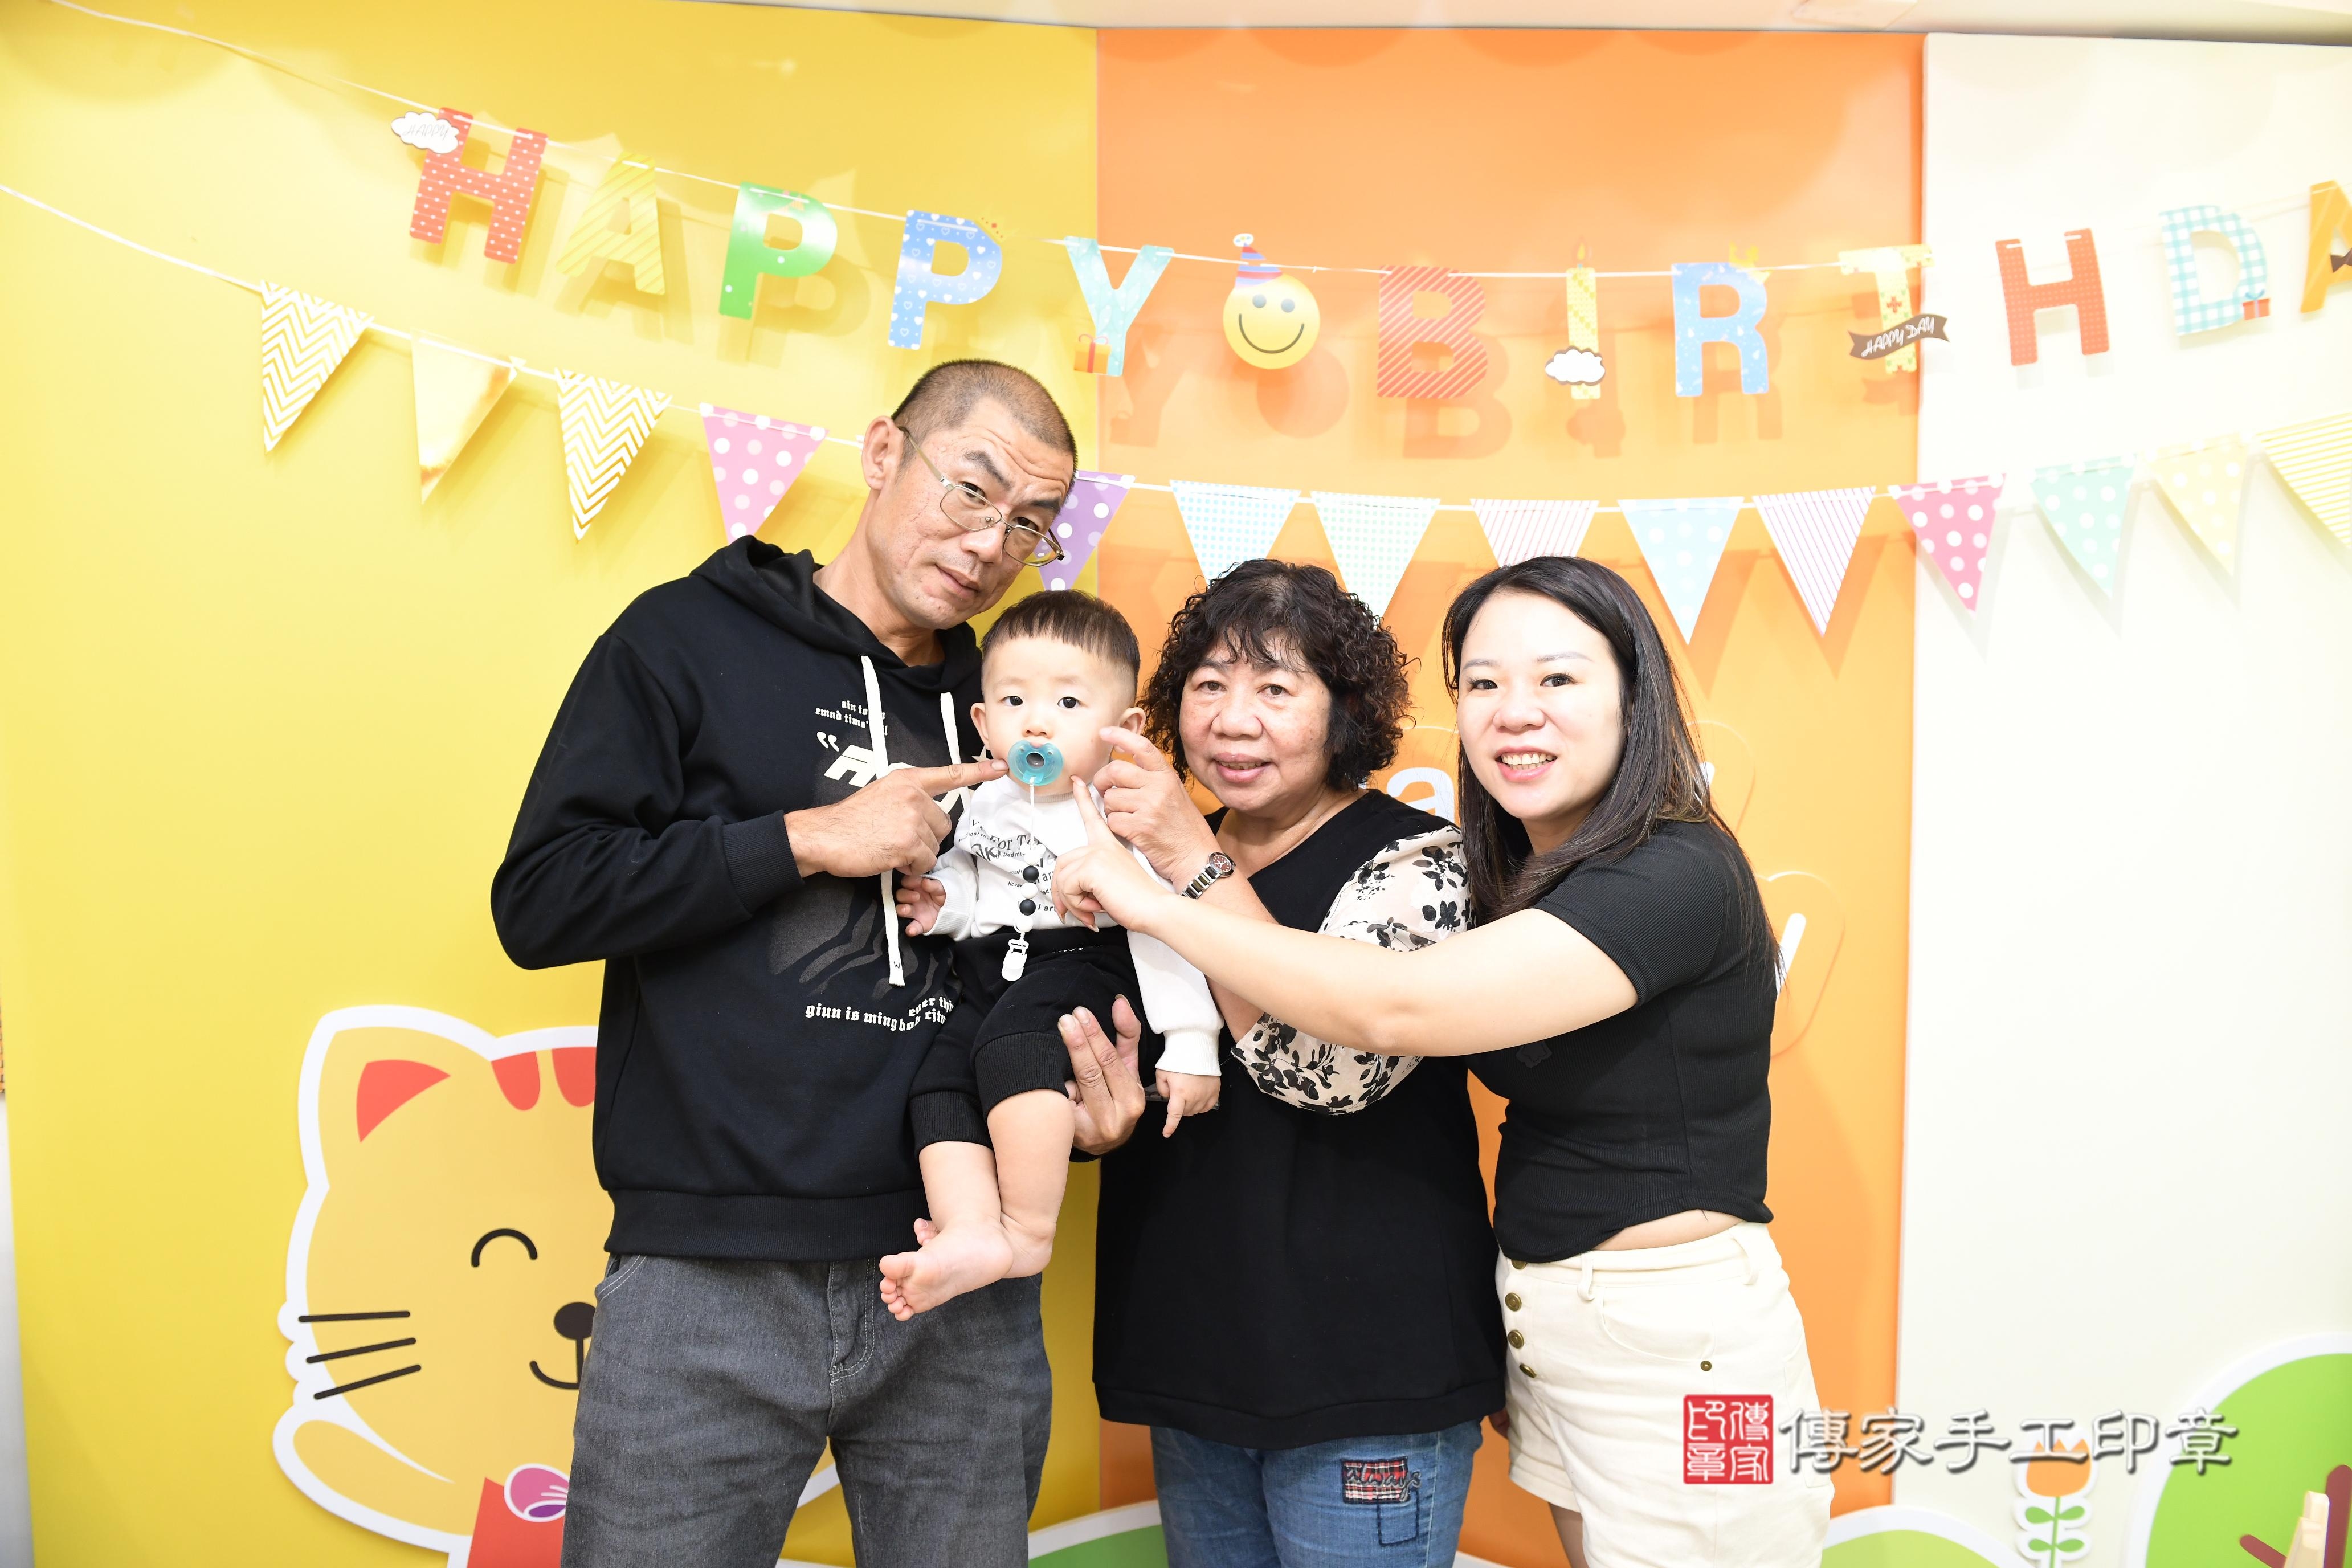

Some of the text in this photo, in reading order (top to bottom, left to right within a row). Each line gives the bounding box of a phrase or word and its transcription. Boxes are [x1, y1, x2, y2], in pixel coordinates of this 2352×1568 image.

[402, 124, 450, 140] HAPPY
[409, 107, 1175, 377] HAPPY
[1861, 316, 1935, 357] HAPPY DAY
[846, 1006, 860, 1021] is
